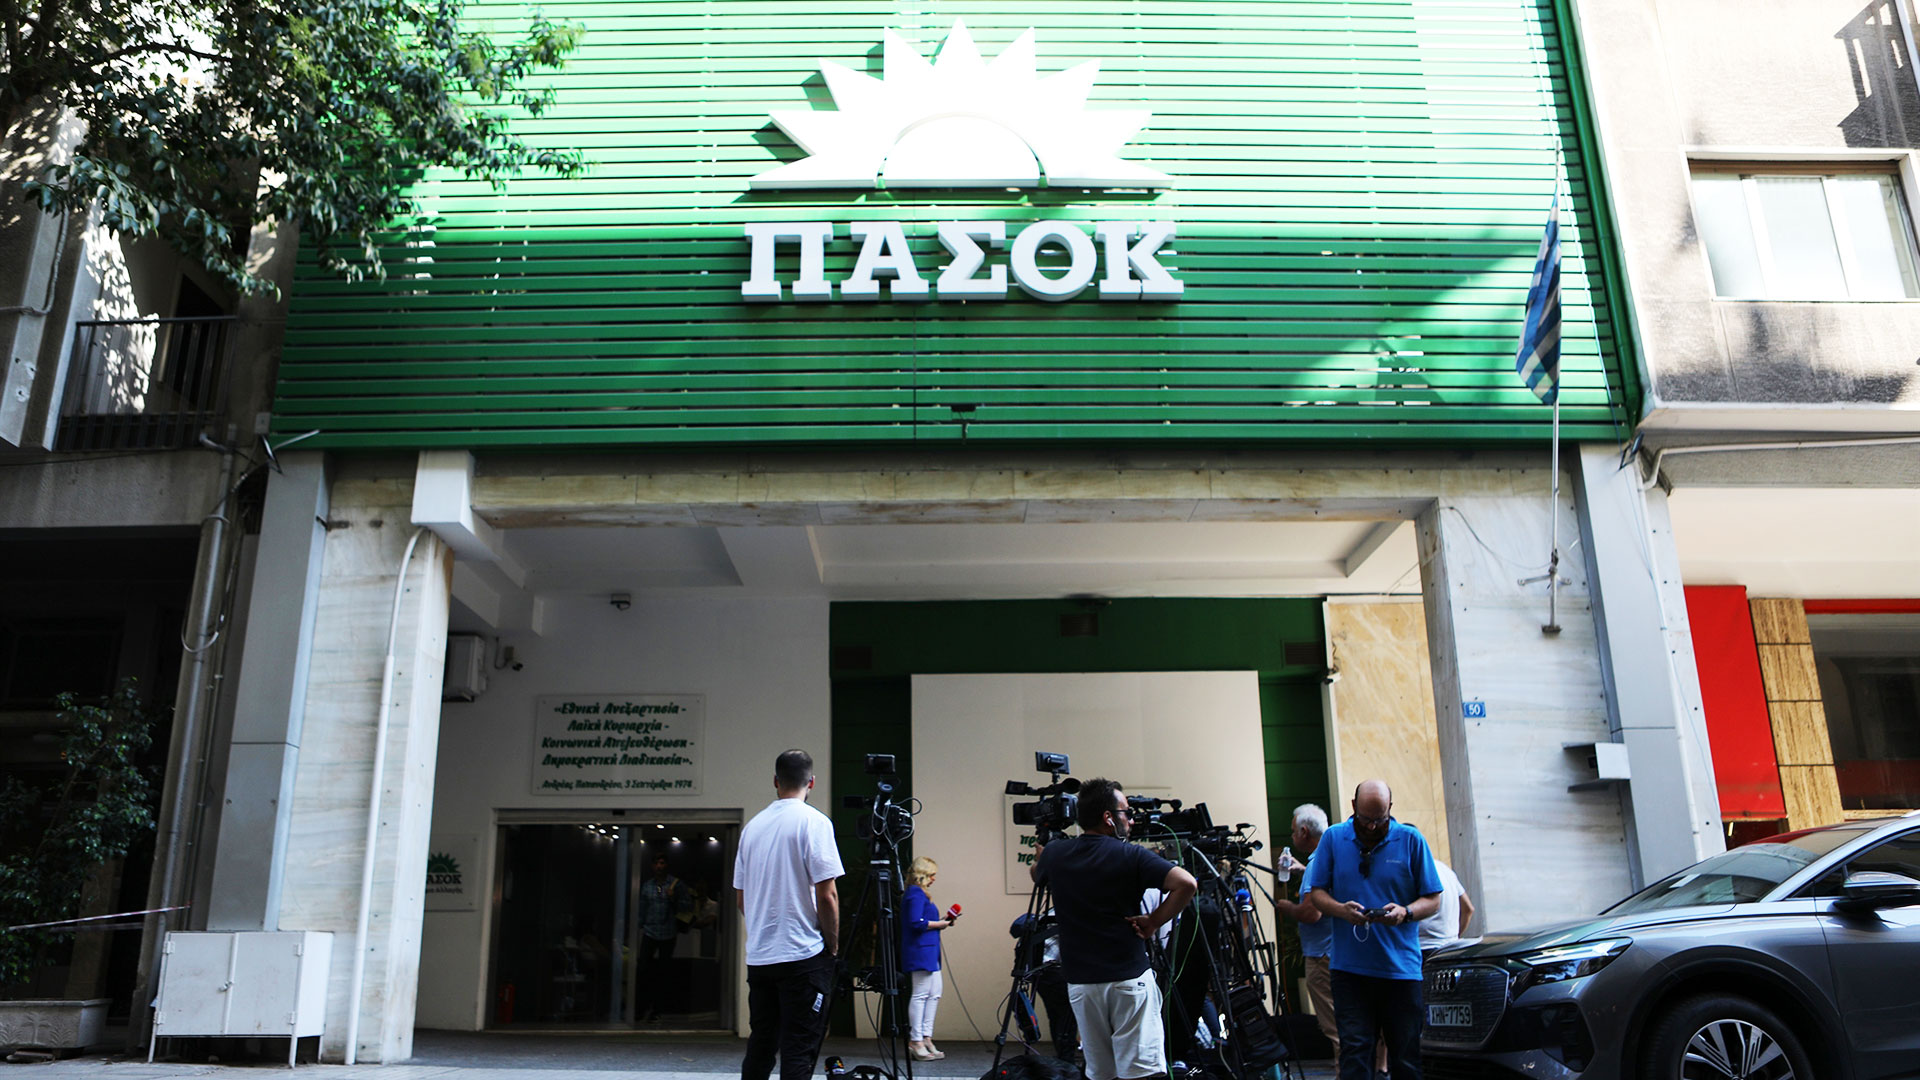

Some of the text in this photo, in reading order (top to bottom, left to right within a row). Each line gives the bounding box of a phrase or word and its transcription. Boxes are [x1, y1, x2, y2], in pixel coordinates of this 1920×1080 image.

[741, 220, 1185, 301] ΠΑΣΟΚ
[554, 702, 600, 715] «Εθνική
[603, 702, 679, 717] Ανεξαρτησία
[1468, 703, 1481, 716] 50
[567, 719, 601, 731] Λαϊκή
[603, 719, 662, 734] Κυριαρχία
[542, 736, 601, 749] Κοινωνική
[541, 753, 618, 768] Δημοκρατική
[426, 874, 462, 884] ΑΣΟΚ
